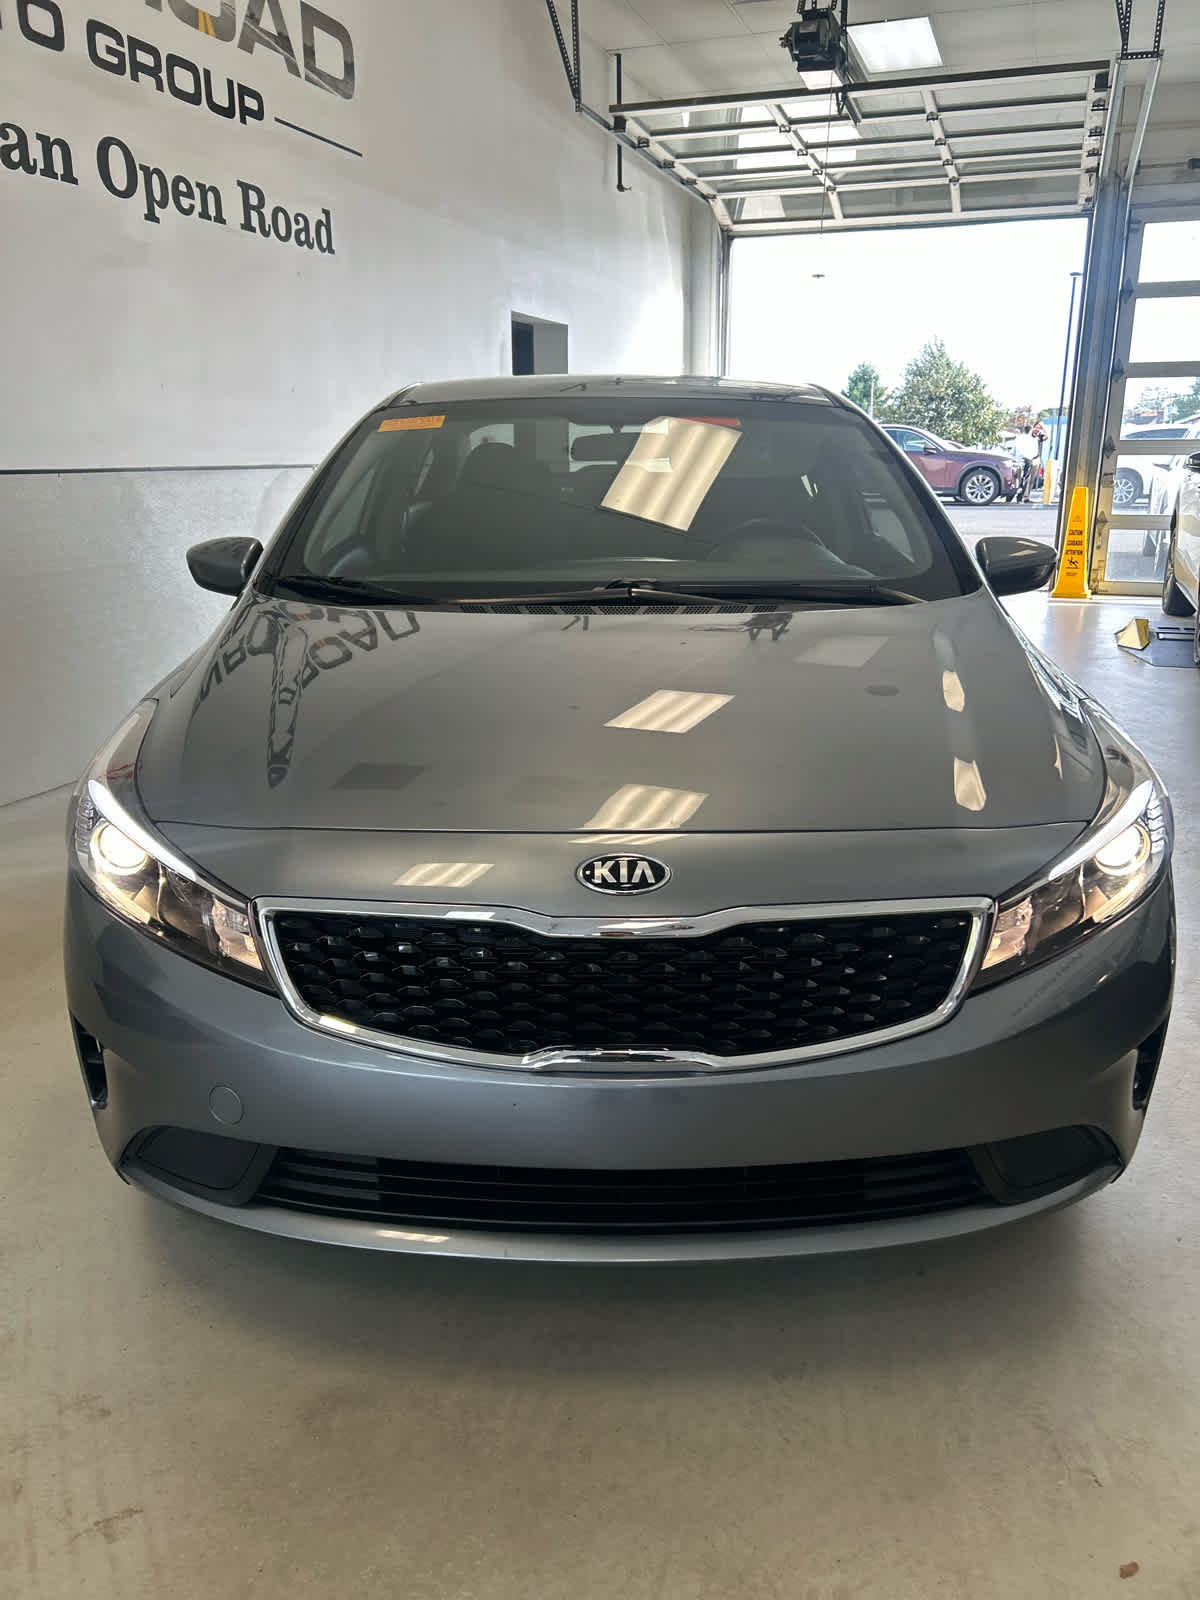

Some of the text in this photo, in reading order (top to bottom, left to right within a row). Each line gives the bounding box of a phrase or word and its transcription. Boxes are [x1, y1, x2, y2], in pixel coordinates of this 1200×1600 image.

[86, 18, 265, 125] GROUP
[145, 0, 356, 100] AD
[0, 122, 336, 255] an Open Road
[591, 860, 656, 884] KIA
